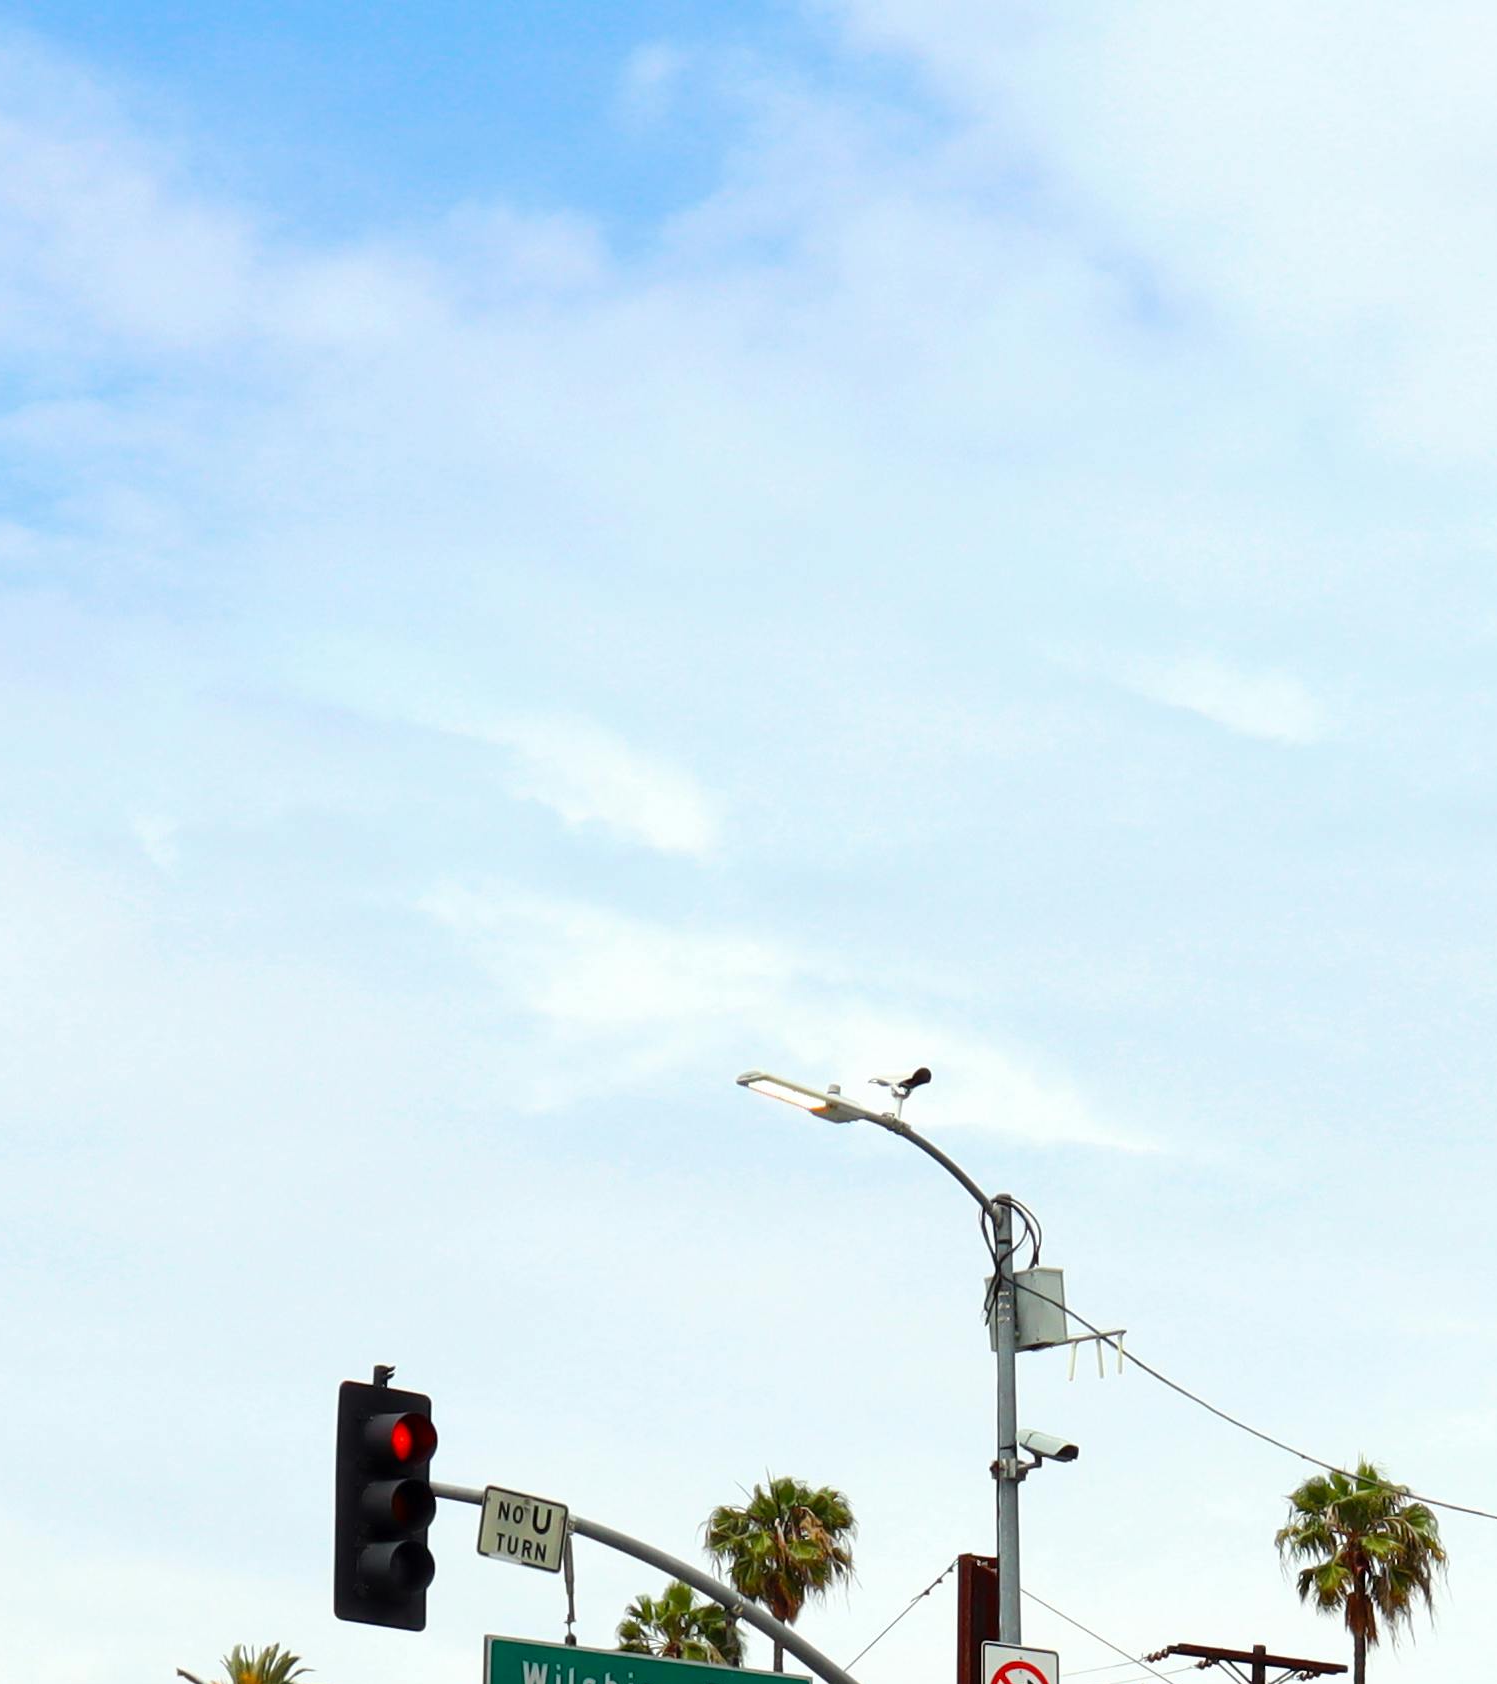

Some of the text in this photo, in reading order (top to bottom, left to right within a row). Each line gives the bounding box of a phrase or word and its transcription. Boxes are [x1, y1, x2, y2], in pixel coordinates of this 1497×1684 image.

[498, 1501, 552, 1535] NO U
[496, 1532, 546, 1563] TURN
